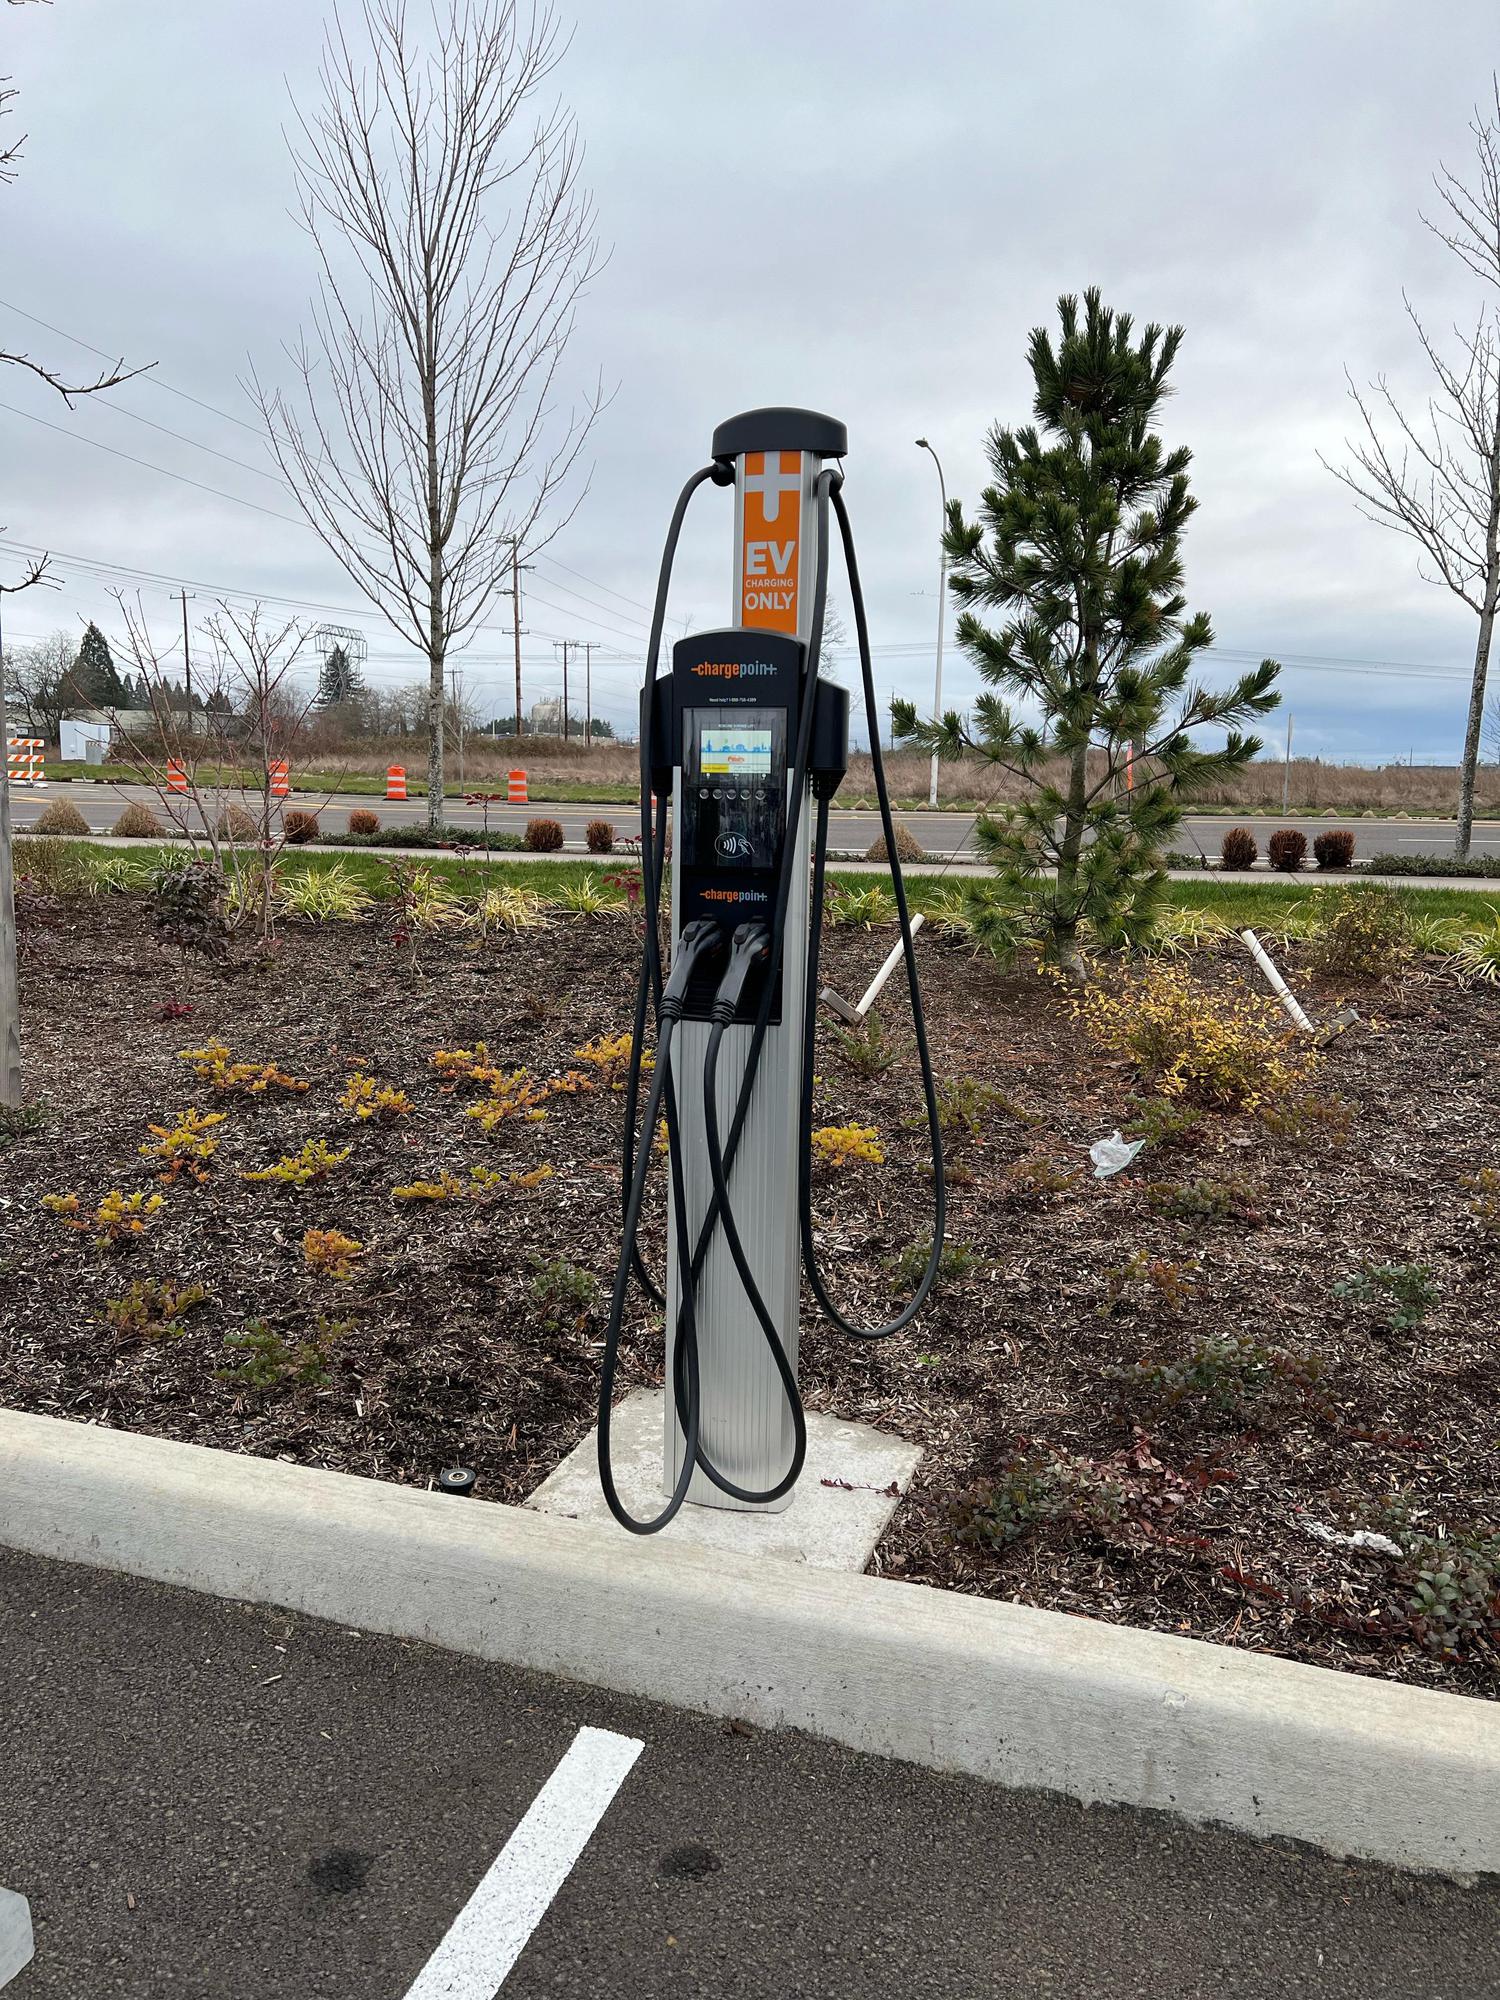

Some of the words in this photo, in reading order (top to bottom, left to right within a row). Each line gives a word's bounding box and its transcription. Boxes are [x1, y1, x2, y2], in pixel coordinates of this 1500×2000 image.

[746, 541, 796, 575] EV
[745, 578, 794, 588] CHARGING
[744, 591, 795, 610] ONLY
